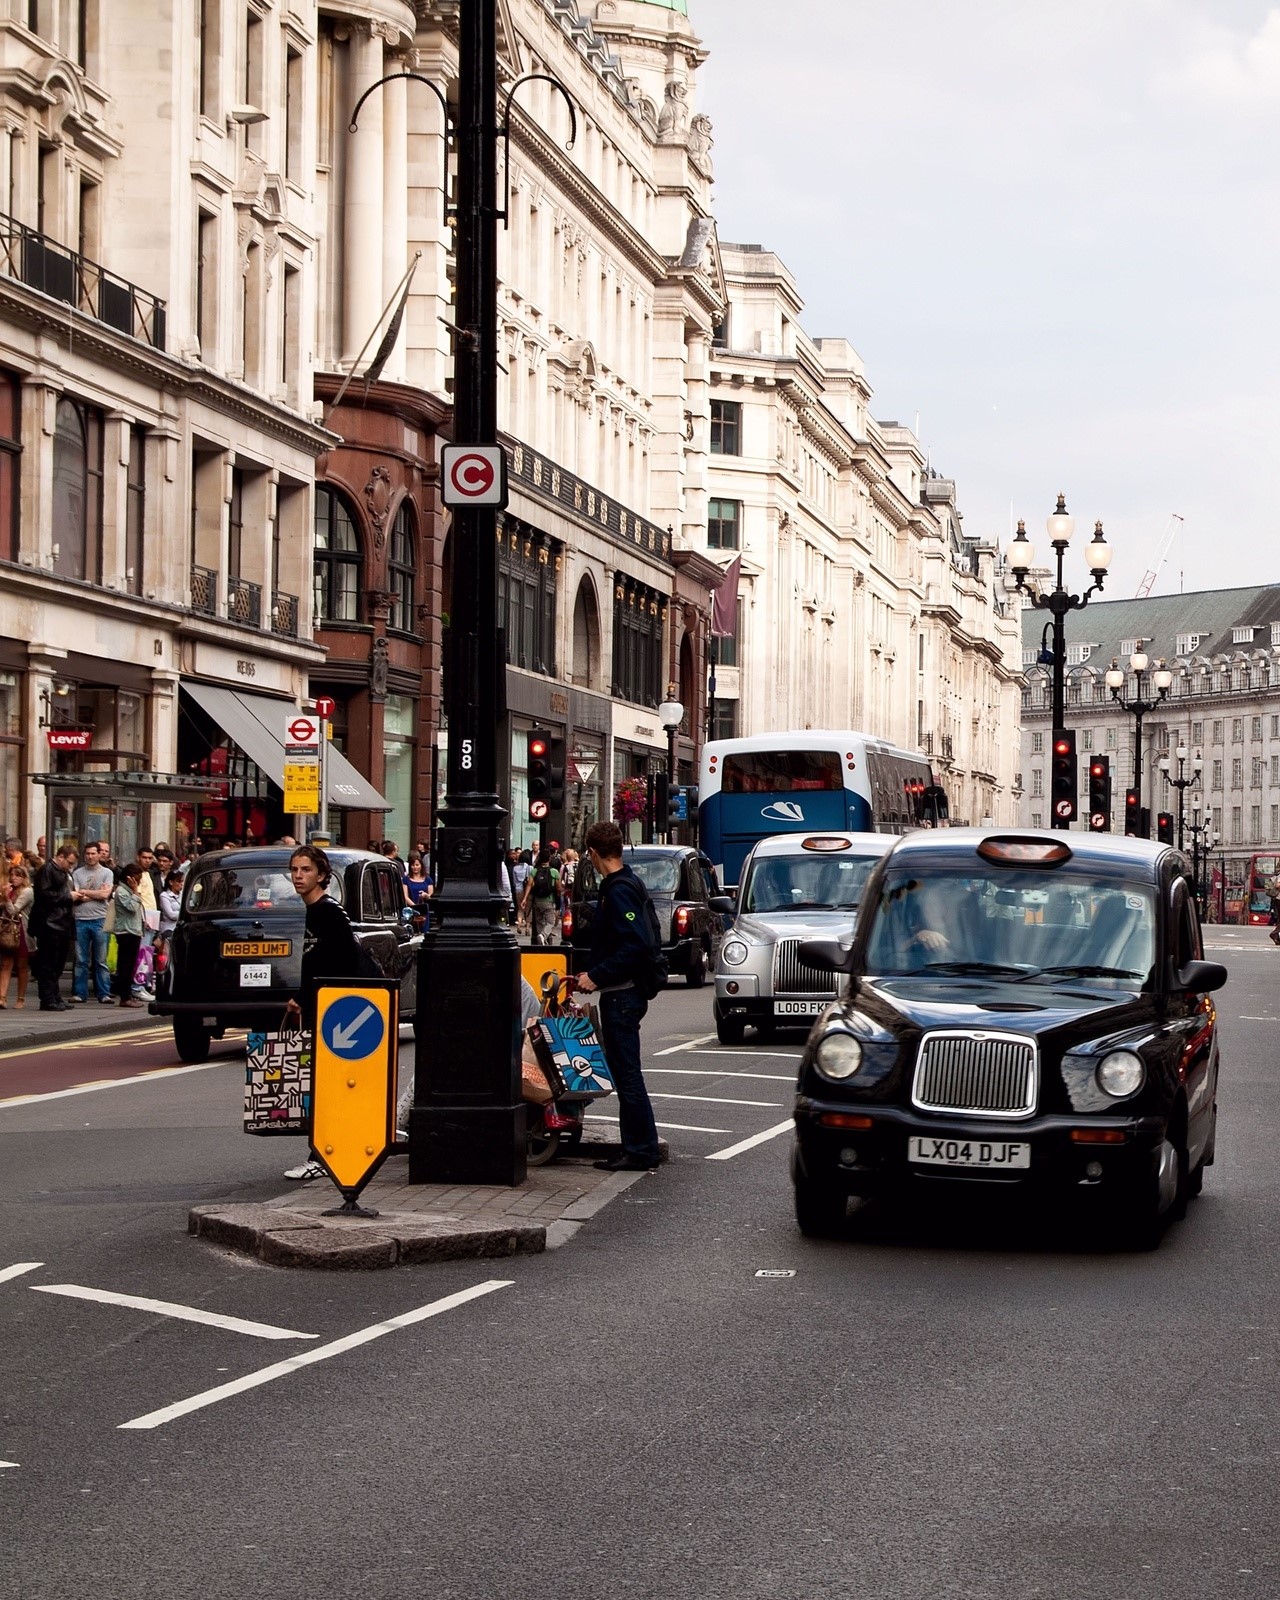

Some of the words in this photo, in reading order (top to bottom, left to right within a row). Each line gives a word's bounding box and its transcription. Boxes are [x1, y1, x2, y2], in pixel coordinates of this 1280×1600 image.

[236, 659, 256, 677] REISS
[319, 700, 331, 714] T
[334, 784, 360, 795] REISS
[224, 944, 259, 955] M883
[262, 943, 288, 955] UMT
[917, 1138, 973, 1161] LX04
[979, 1143, 1021, 1163] DJF
